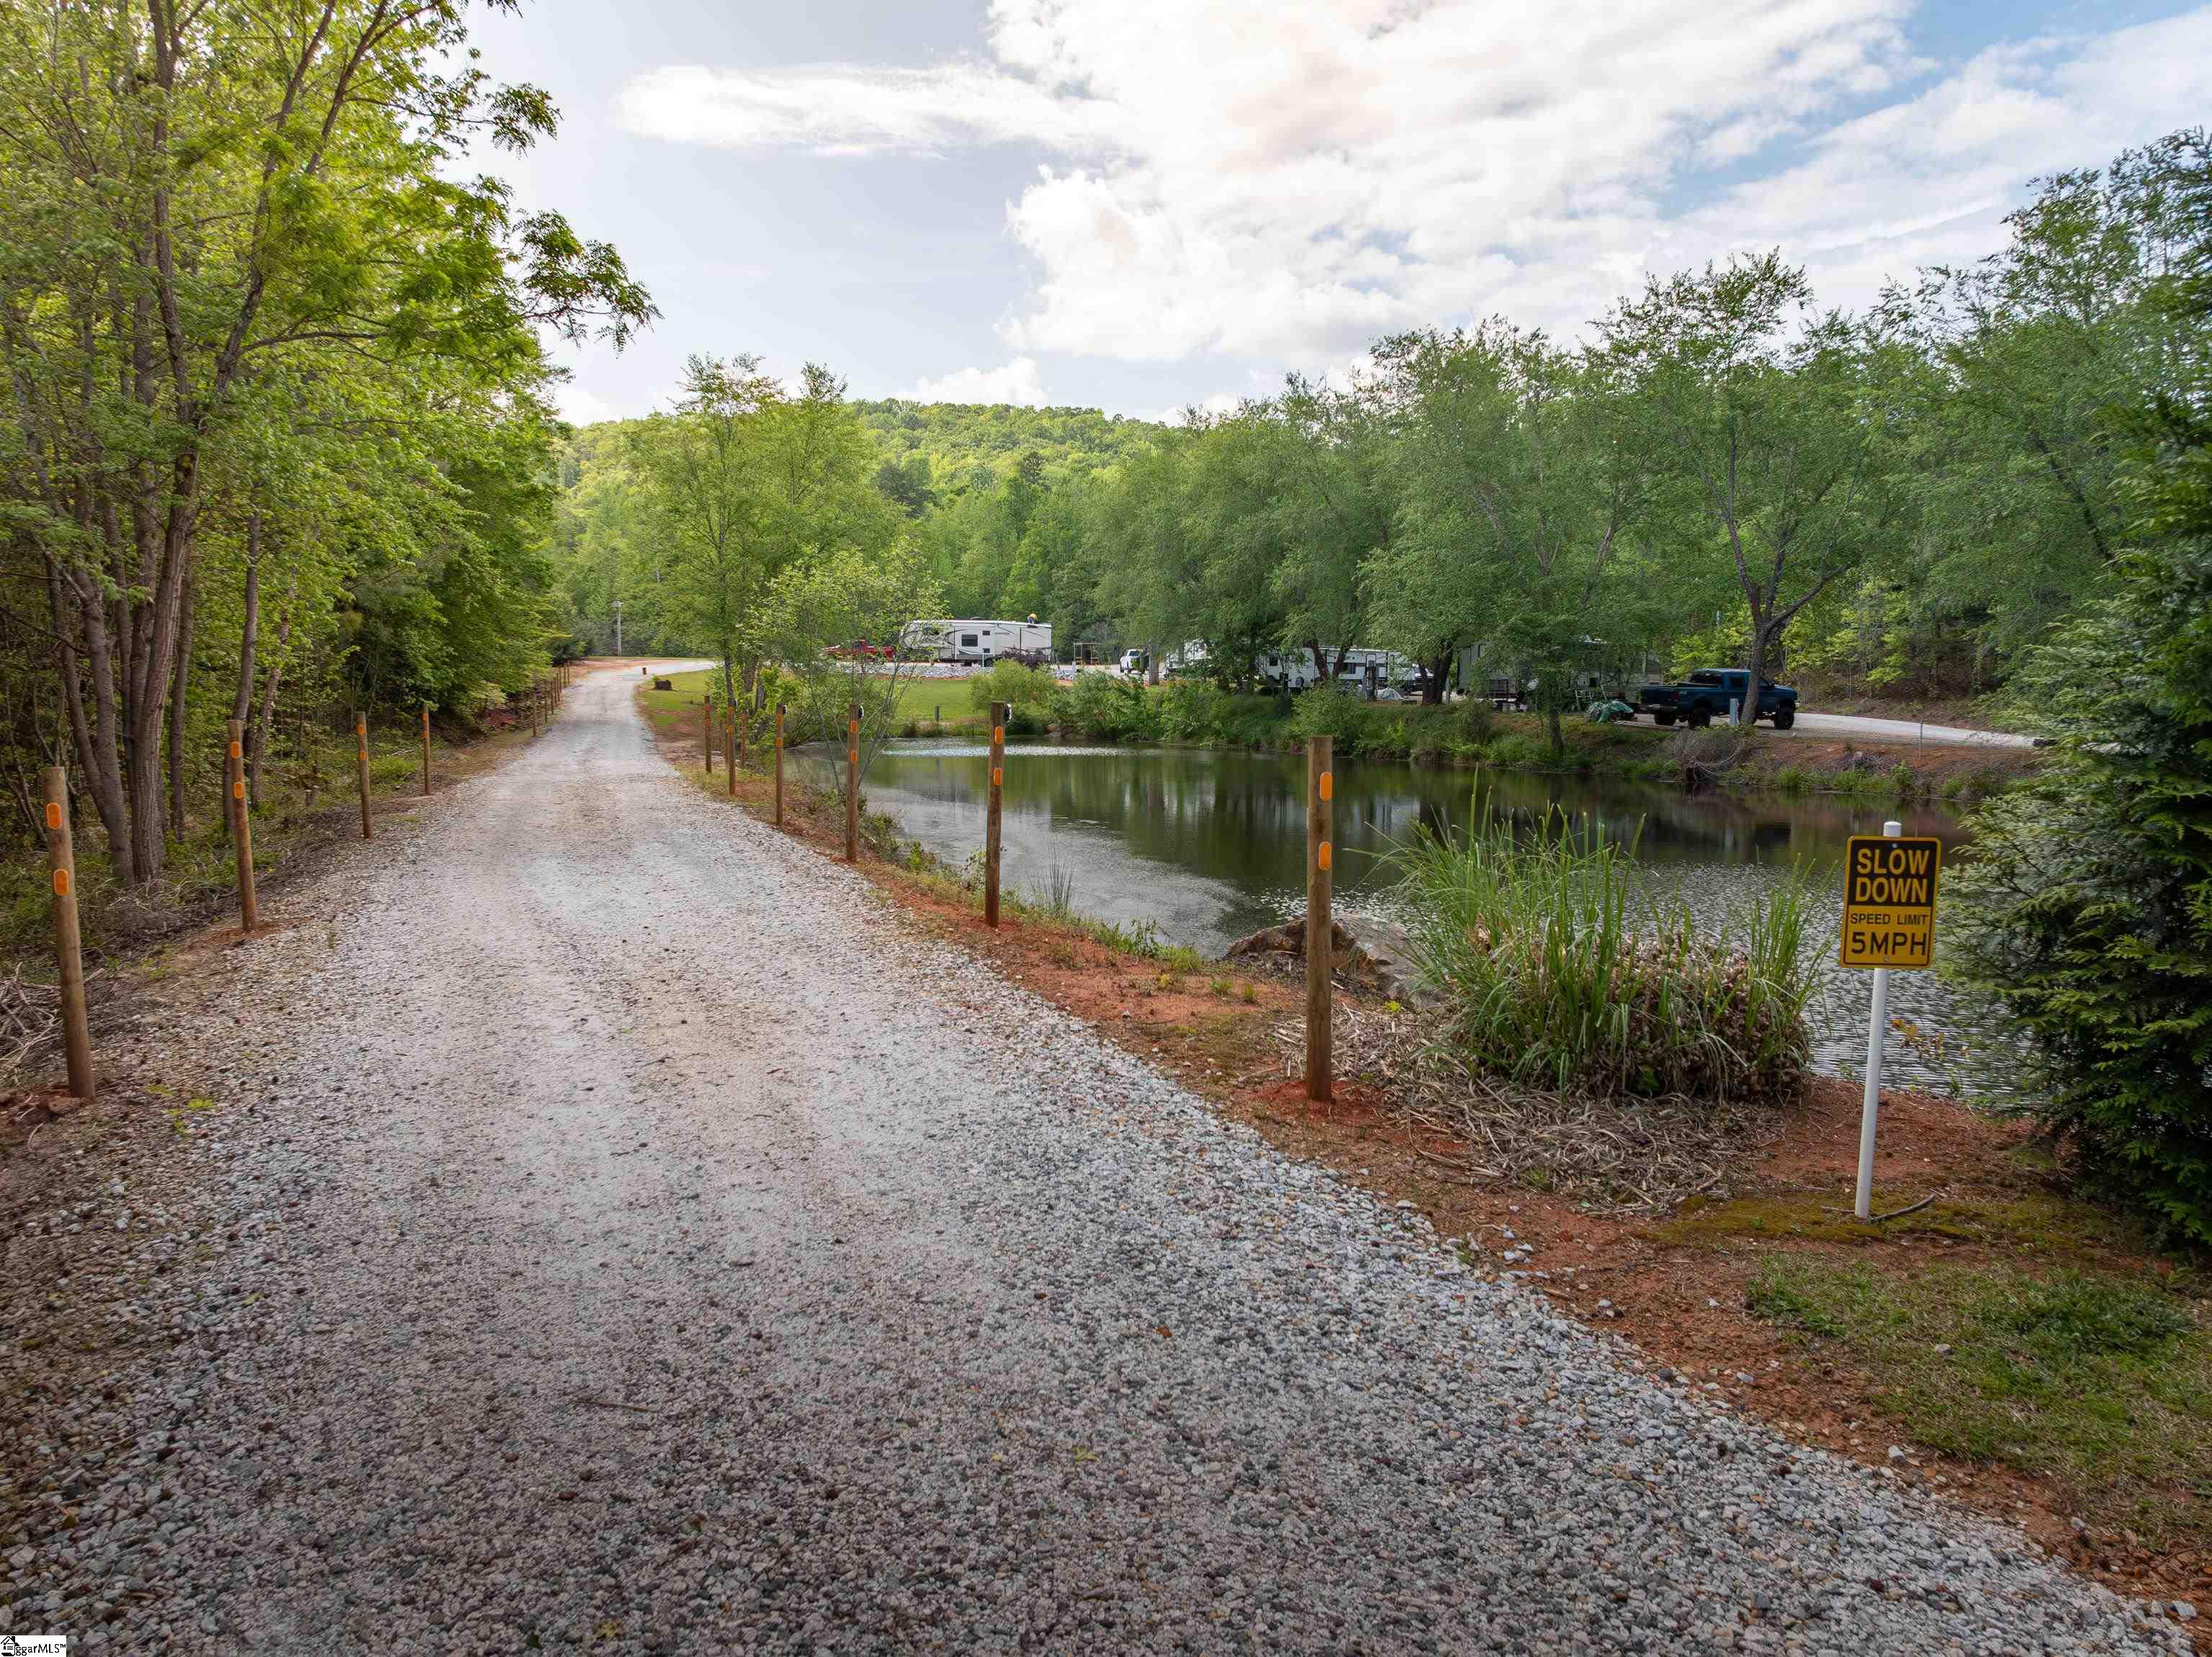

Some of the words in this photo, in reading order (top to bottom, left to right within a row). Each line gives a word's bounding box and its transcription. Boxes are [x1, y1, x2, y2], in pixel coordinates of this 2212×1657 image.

[1856, 848, 1929, 875] SLOW
[1855, 877, 1927, 903] DOWN
[1850, 912, 1891, 925] SPEED
[1897, 914, 1928, 926] LIMIT
